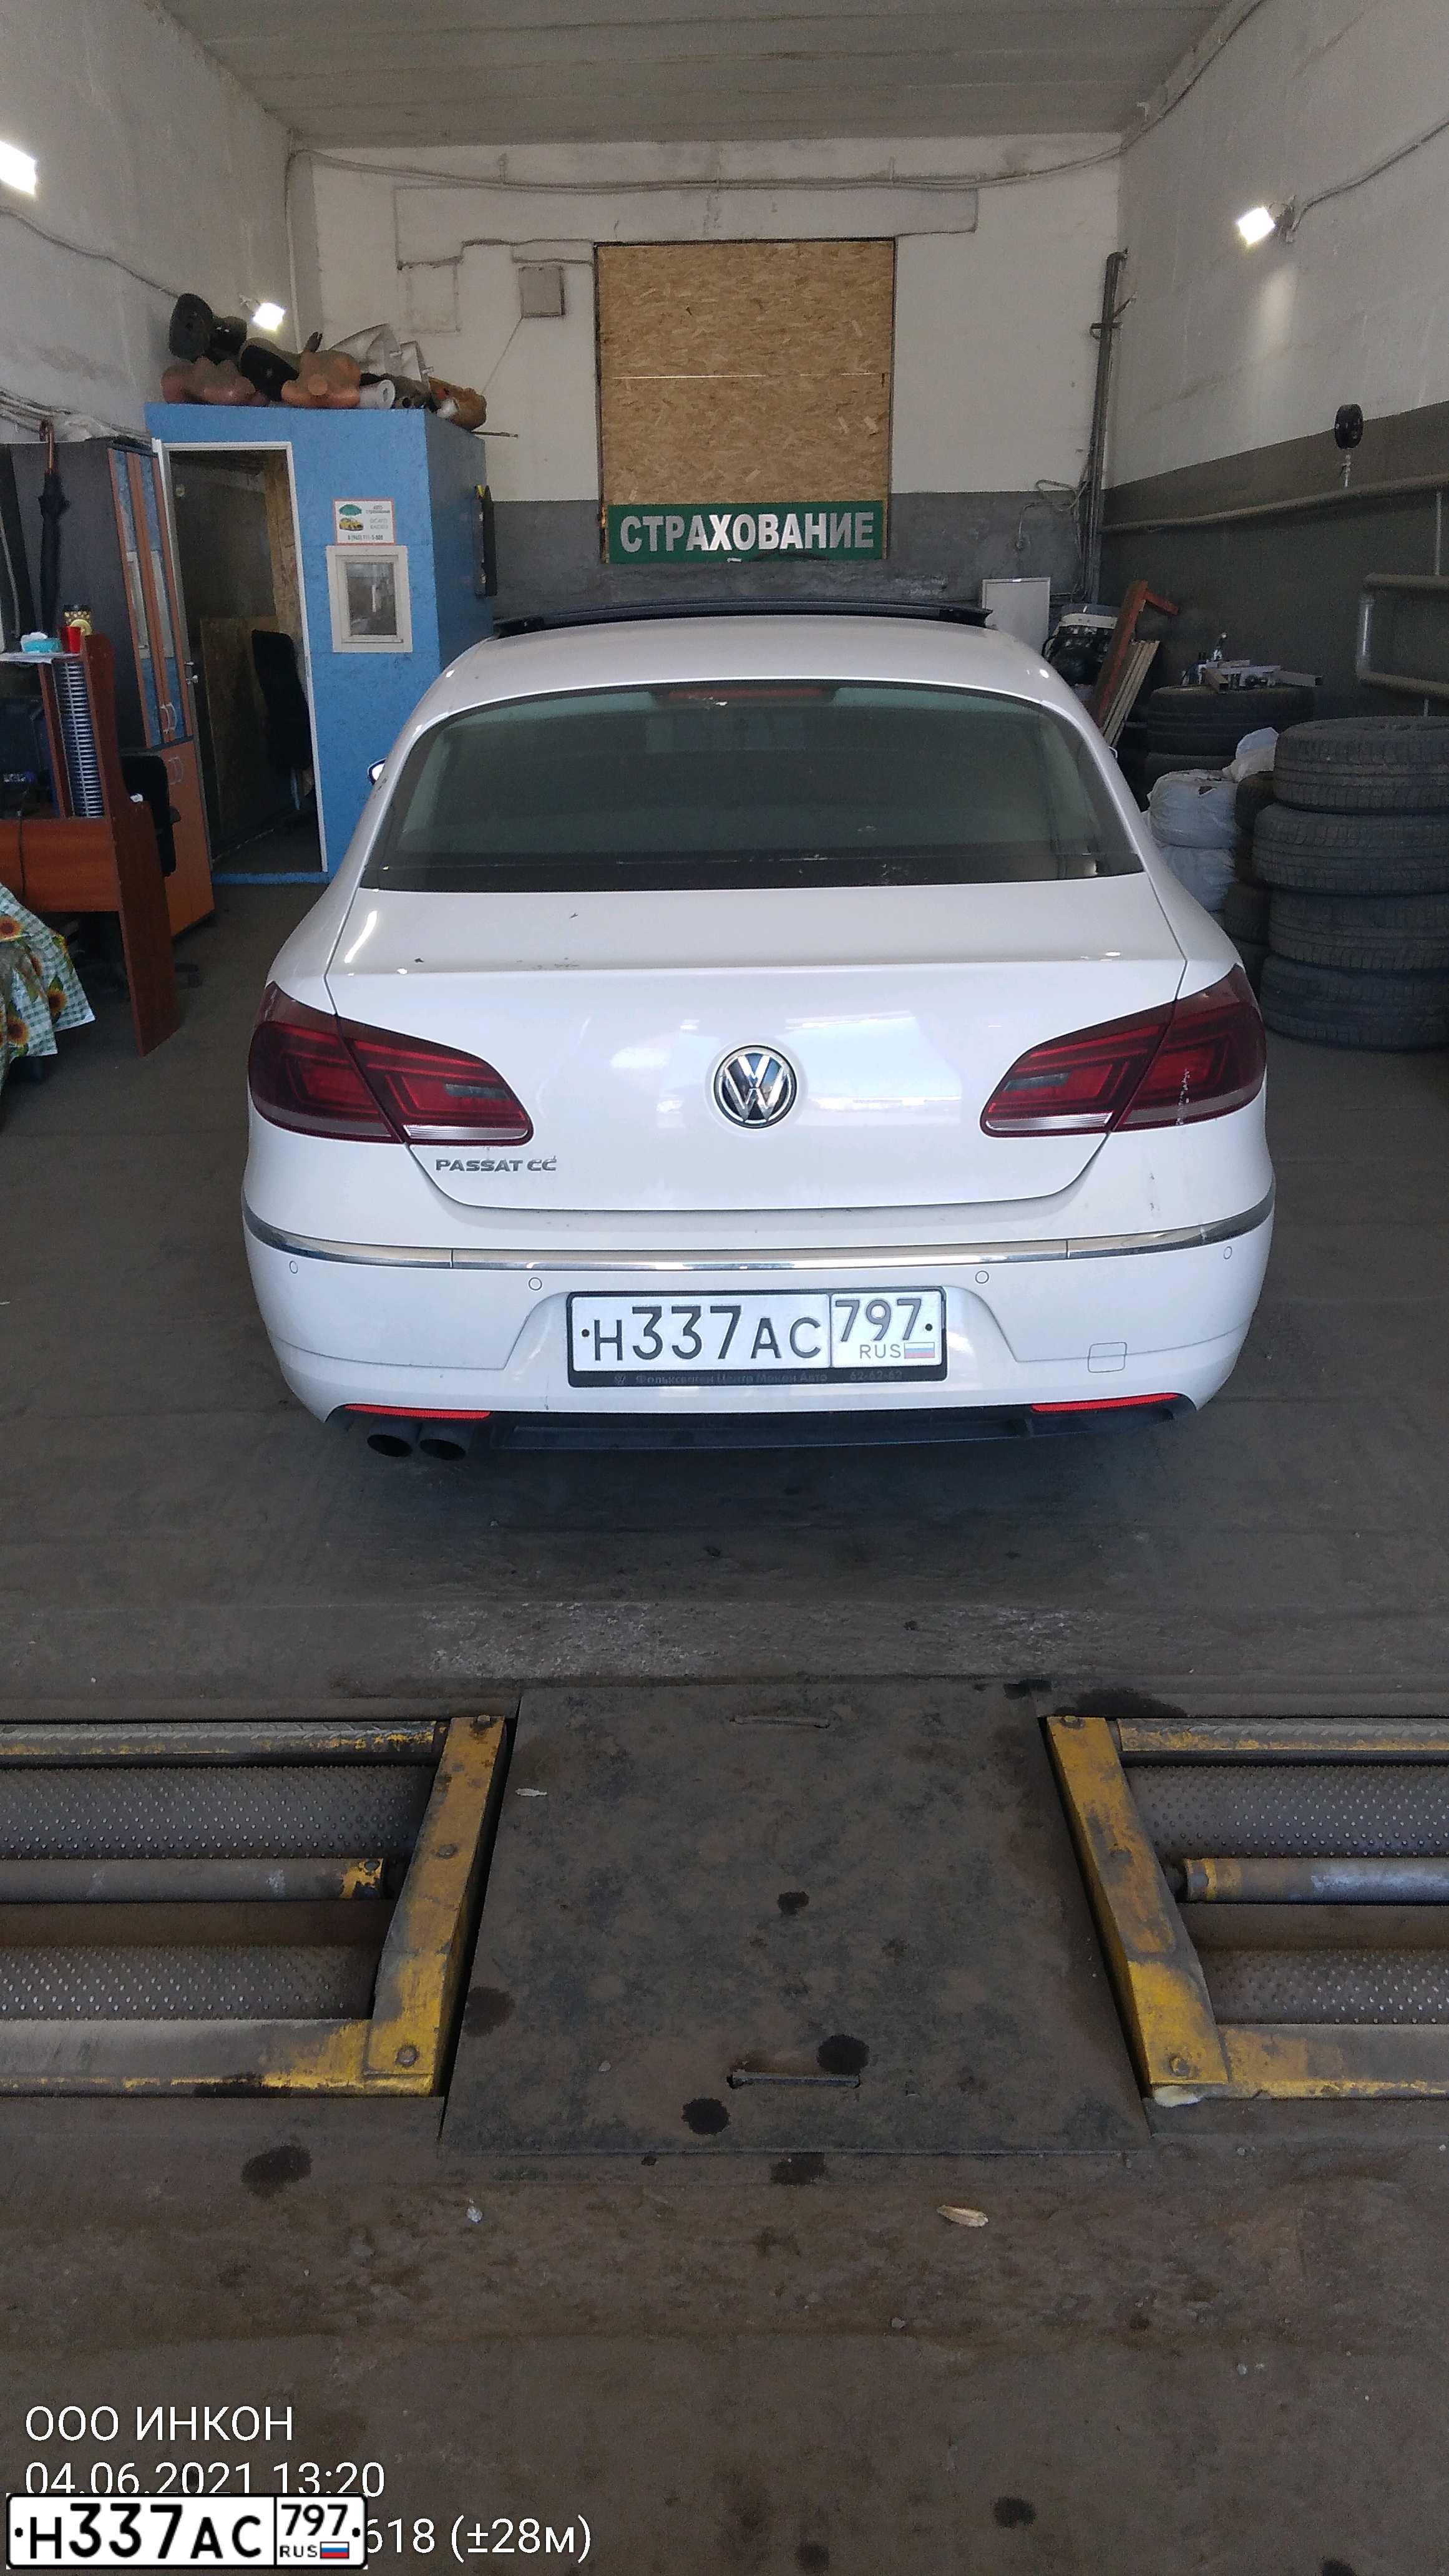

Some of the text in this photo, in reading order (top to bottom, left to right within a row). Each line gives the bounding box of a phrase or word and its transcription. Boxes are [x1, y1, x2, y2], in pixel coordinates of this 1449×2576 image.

[620, 512, 874, 553] СТРАХОВАНИЕ
[435, 1158, 557, 1172] PASSAT CC
[593, 1298, 922, 1361] Н337АС 797
[859, 1344, 901, 1359] RUS
